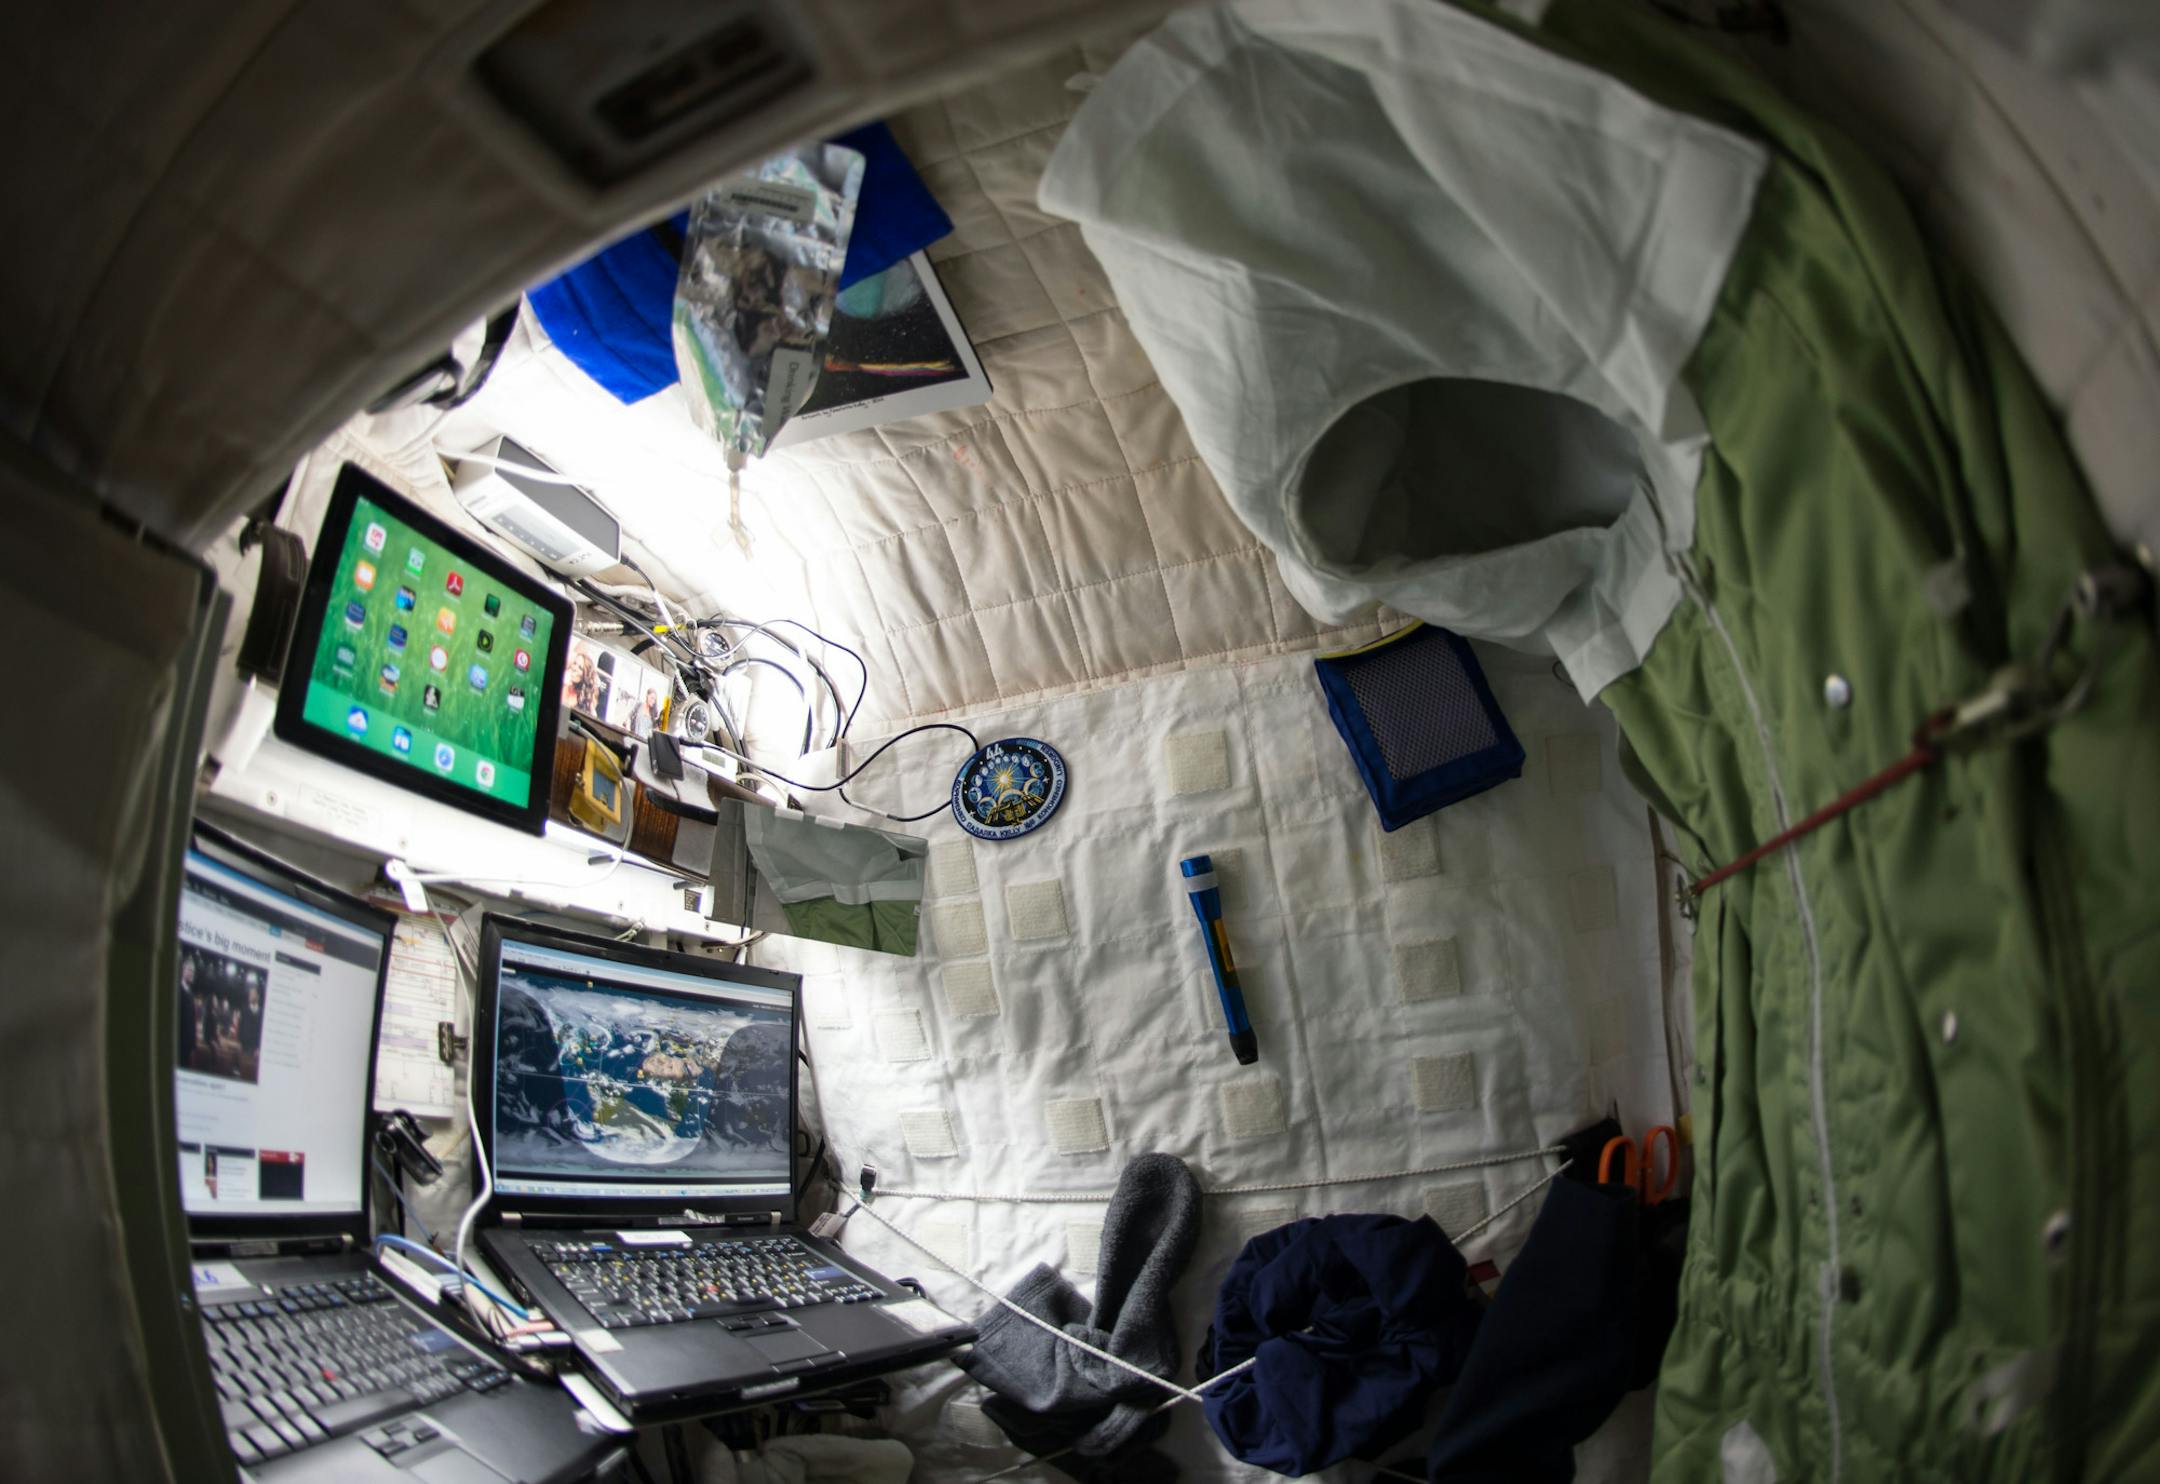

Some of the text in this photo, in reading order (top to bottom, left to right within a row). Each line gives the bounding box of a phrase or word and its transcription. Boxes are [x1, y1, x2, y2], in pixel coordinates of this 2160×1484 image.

[986, 743, 1005, 760] 44
[214, 931, 230, 949] big
[231, 941, 272, 962] moment
